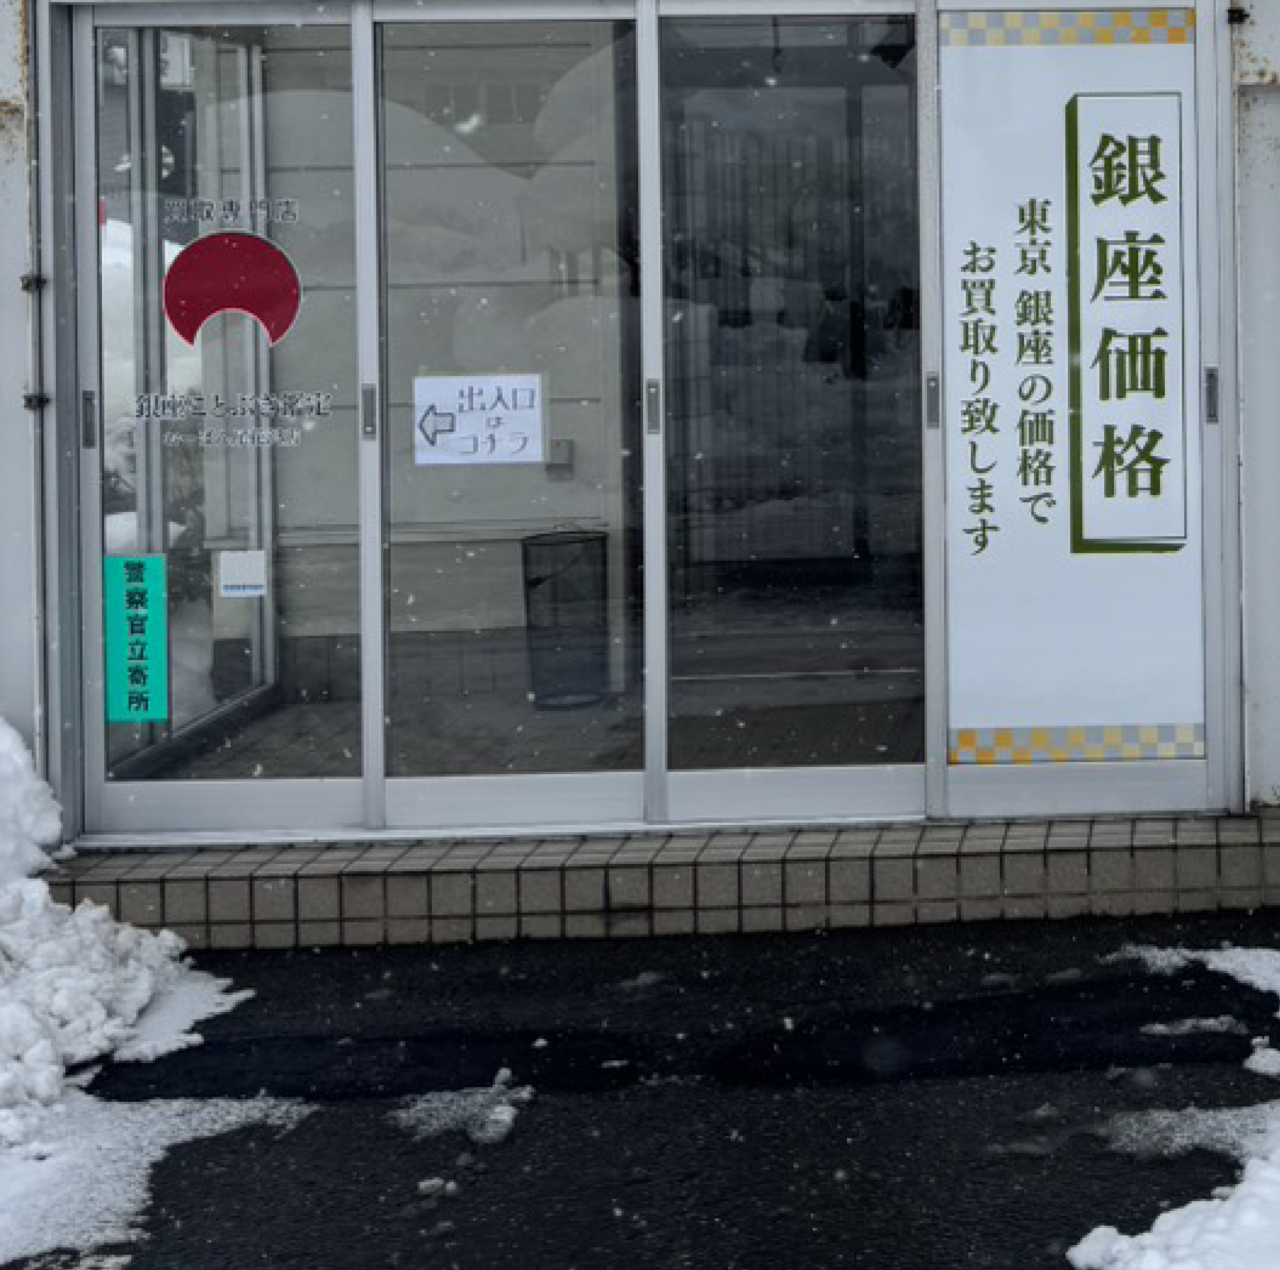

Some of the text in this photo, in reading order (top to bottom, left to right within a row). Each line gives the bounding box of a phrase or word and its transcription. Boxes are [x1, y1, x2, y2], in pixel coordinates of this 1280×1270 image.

[457, 384, 536, 414] 出入口
[457, 430, 531, 456] コチラ
[958, 240, 1002, 558] お買取り致します
[1012, 197, 1056, 526] 東京 銀座の価格で
[1088, 130, 1172, 501] 銀座価格
